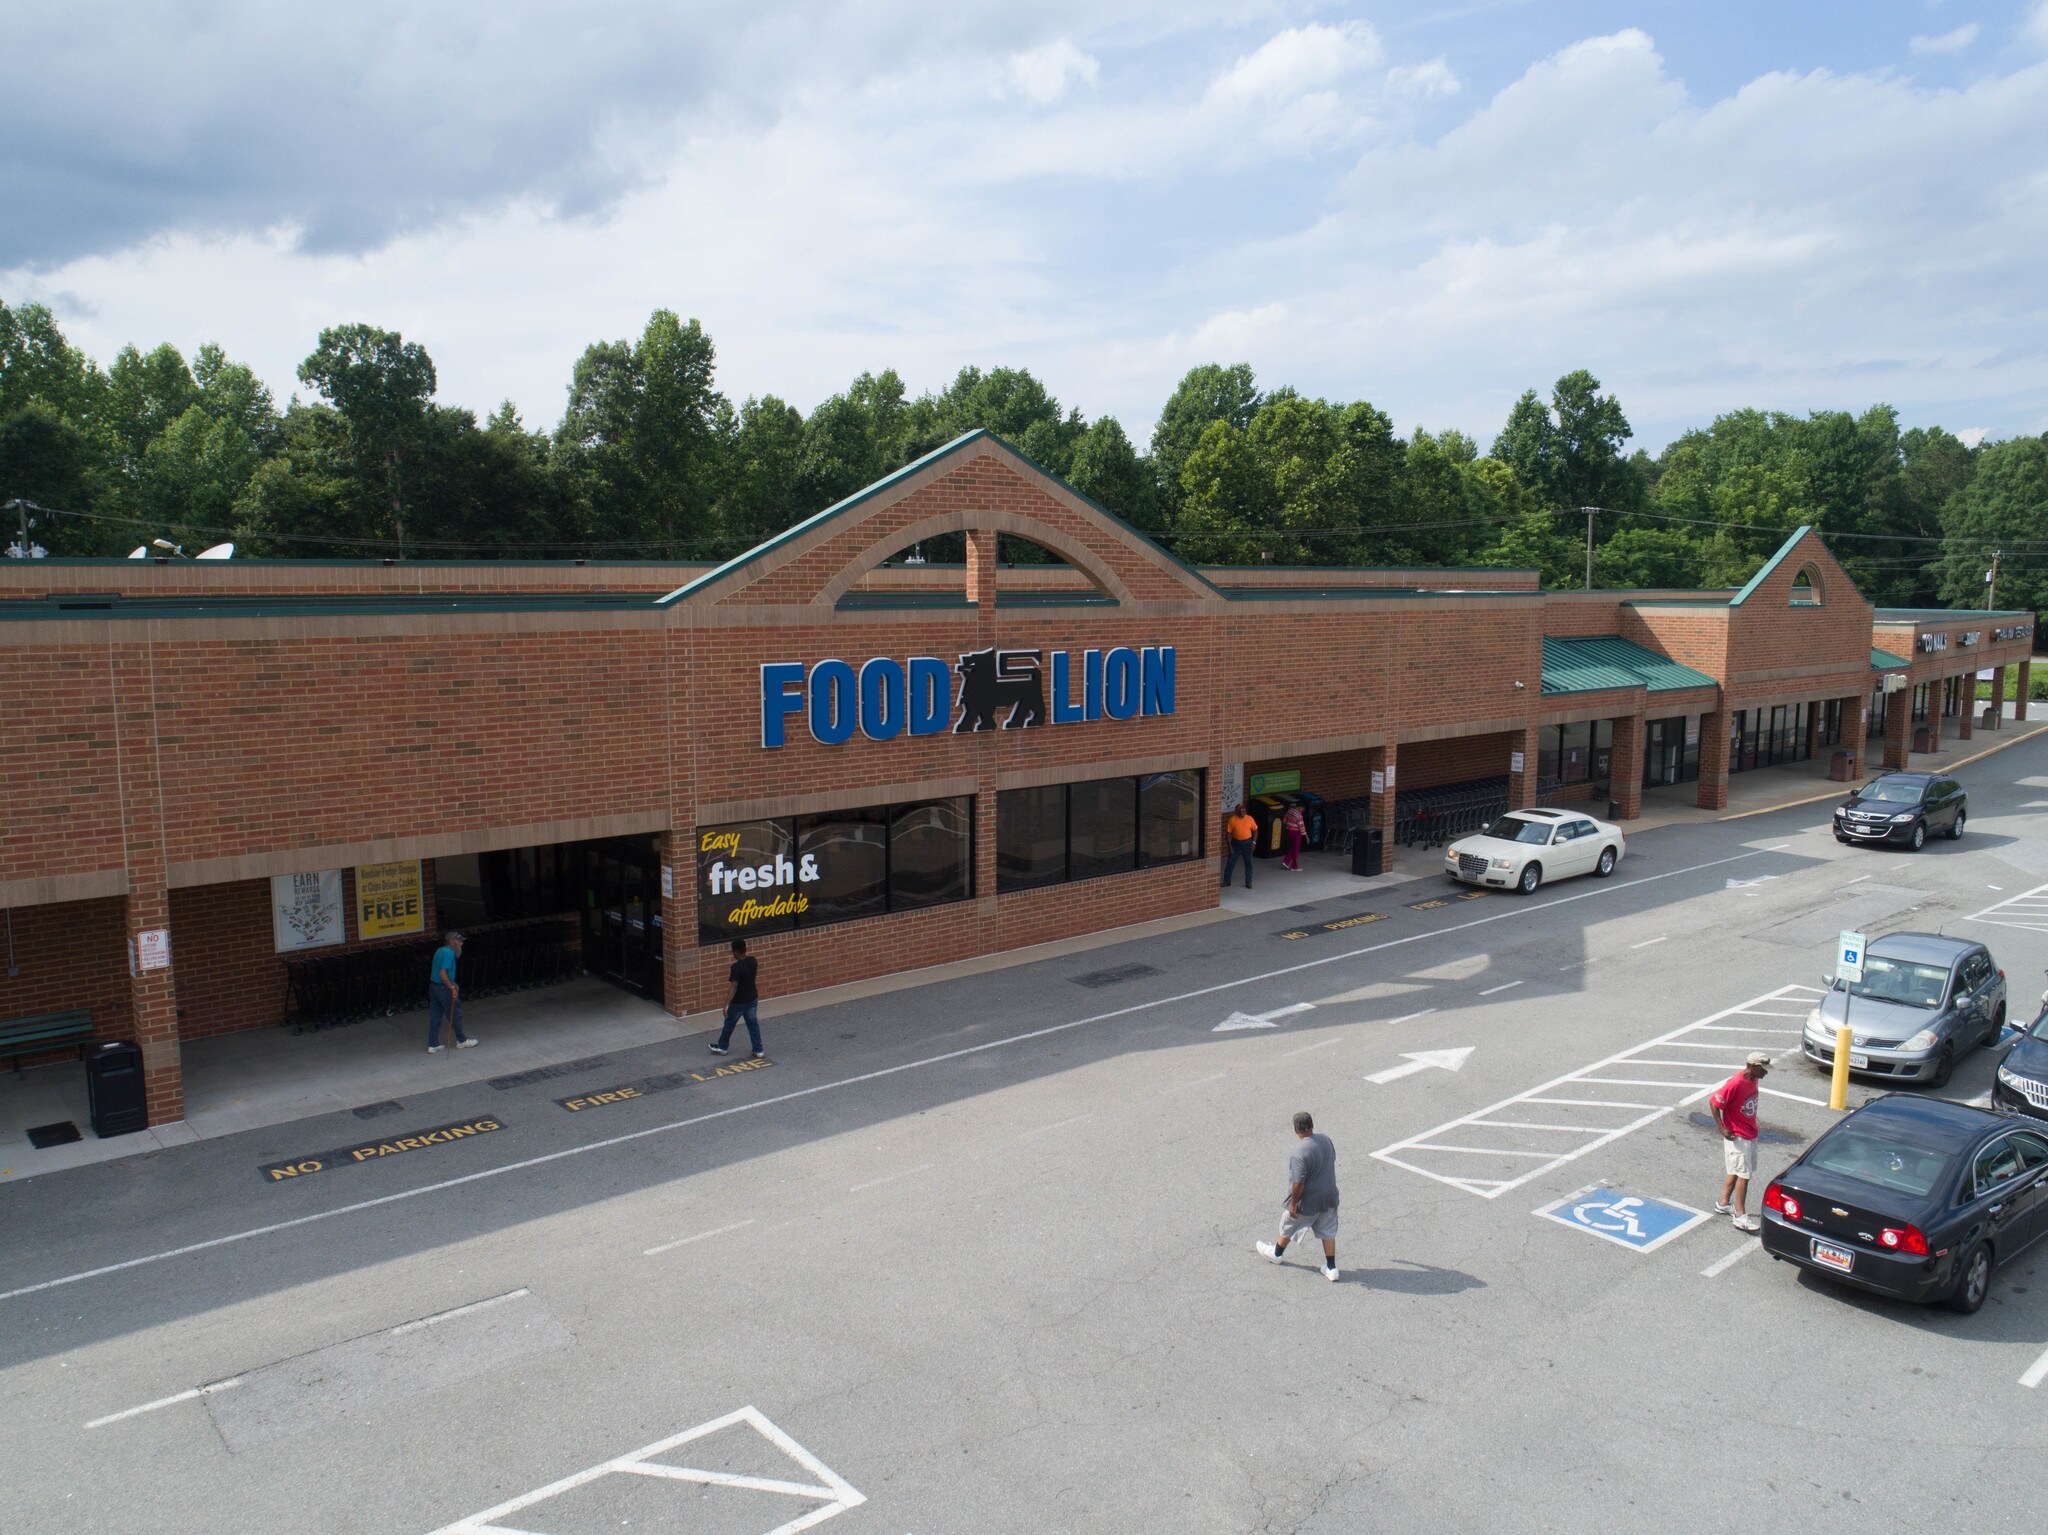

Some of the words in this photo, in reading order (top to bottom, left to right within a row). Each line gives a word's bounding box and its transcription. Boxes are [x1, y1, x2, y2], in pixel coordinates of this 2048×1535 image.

[760, 655, 950, 748] FOOD
[1051, 645, 1177, 724] LION
[701, 831, 741, 858] Easy
[293, 871, 320, 887] EARN
[709, 853, 794, 895] fresh
[799, 853, 820, 882] &
[294, 884, 320, 895] REWARDS
[363, 899, 418, 921] FREE
[728, 893, 809, 926] affordable
[1409, 900, 1449, 911] FIRE
[1281, 930, 1310, 941] NO
[1323, 912, 1389, 931] PARKING
[565, 1087, 643, 1112] FIRE
[691, 1058, 773, 1082] LANE
[270, 1160, 323, 1182] NO
[351, 1119, 500, 1161] PARKING
